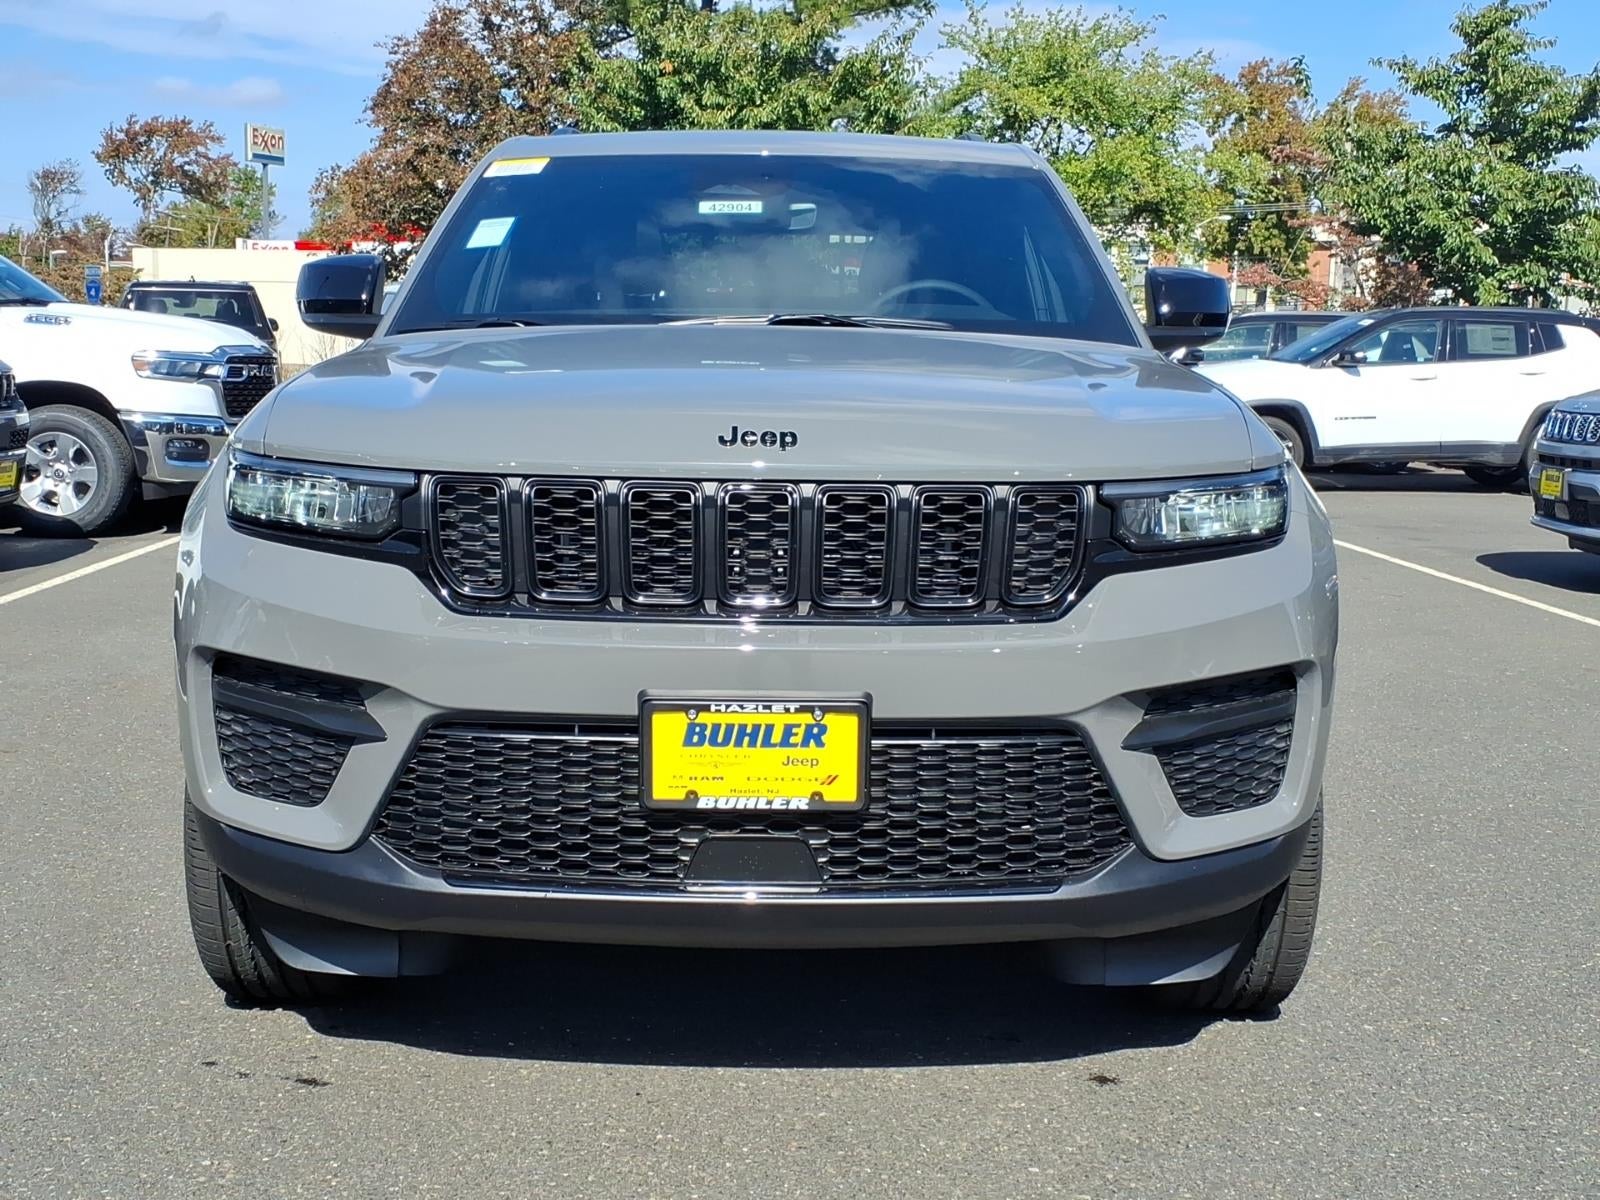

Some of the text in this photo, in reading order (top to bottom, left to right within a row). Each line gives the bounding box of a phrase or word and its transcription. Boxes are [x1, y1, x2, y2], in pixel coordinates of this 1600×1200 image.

[252, 127, 284, 154] Exxon
[708, 203, 753, 212] 42904
[717, 425, 799, 452] Jeep
[710, 703, 800, 713] HAZLET
[682, 722, 829, 749] BUHLER
[781, 755, 820, 769] Jeep
[696, 796, 810, 810] BUHLER
